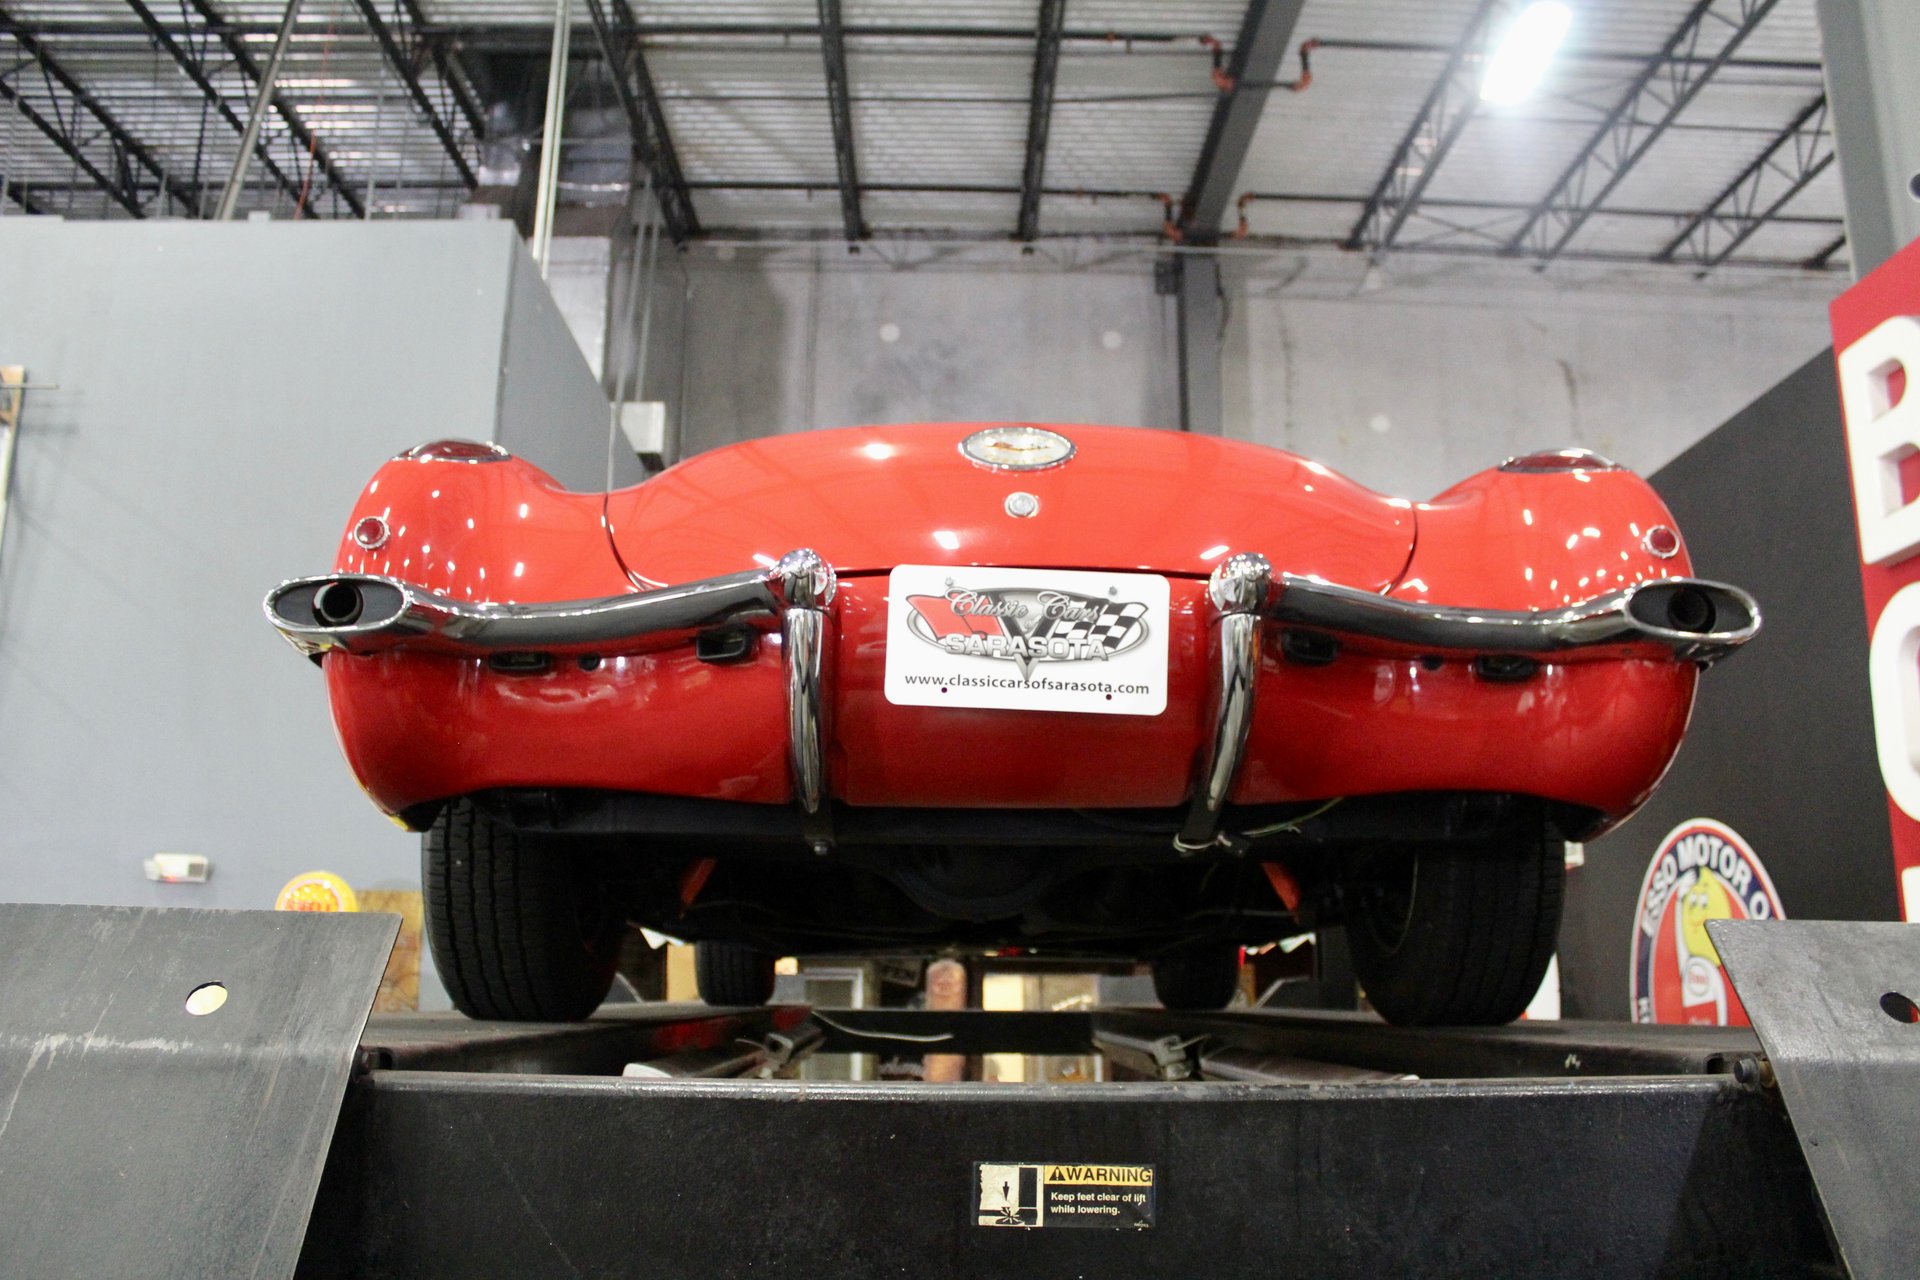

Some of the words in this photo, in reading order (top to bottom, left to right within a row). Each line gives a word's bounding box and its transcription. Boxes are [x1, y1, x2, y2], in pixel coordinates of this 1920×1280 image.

[945, 587, 1029, 618] Classic
[1037, 591, 1104, 621] Cars
[945, 633, 1109, 661] SARASOTA
[905, 674, 1149, 695] www.classiccarsofsarasota.com
[1641, 853, 1677, 938] ESSO
[1677, 833, 1752, 896] MOTOR
[1066, 1167, 1153, 1183] WARNING
[1050, 1192, 1075, 1203] Keep
[1077, 1192, 1095, 1202] feet
[1097, 1193, 1120, 1202] clear
[1122, 1193, 1132, 1203] of
[1133, 1193, 1147, 1203] lift
[1050, 1205, 1076, 1214] while
[1077, 1205, 1121, 1216] lowering.
